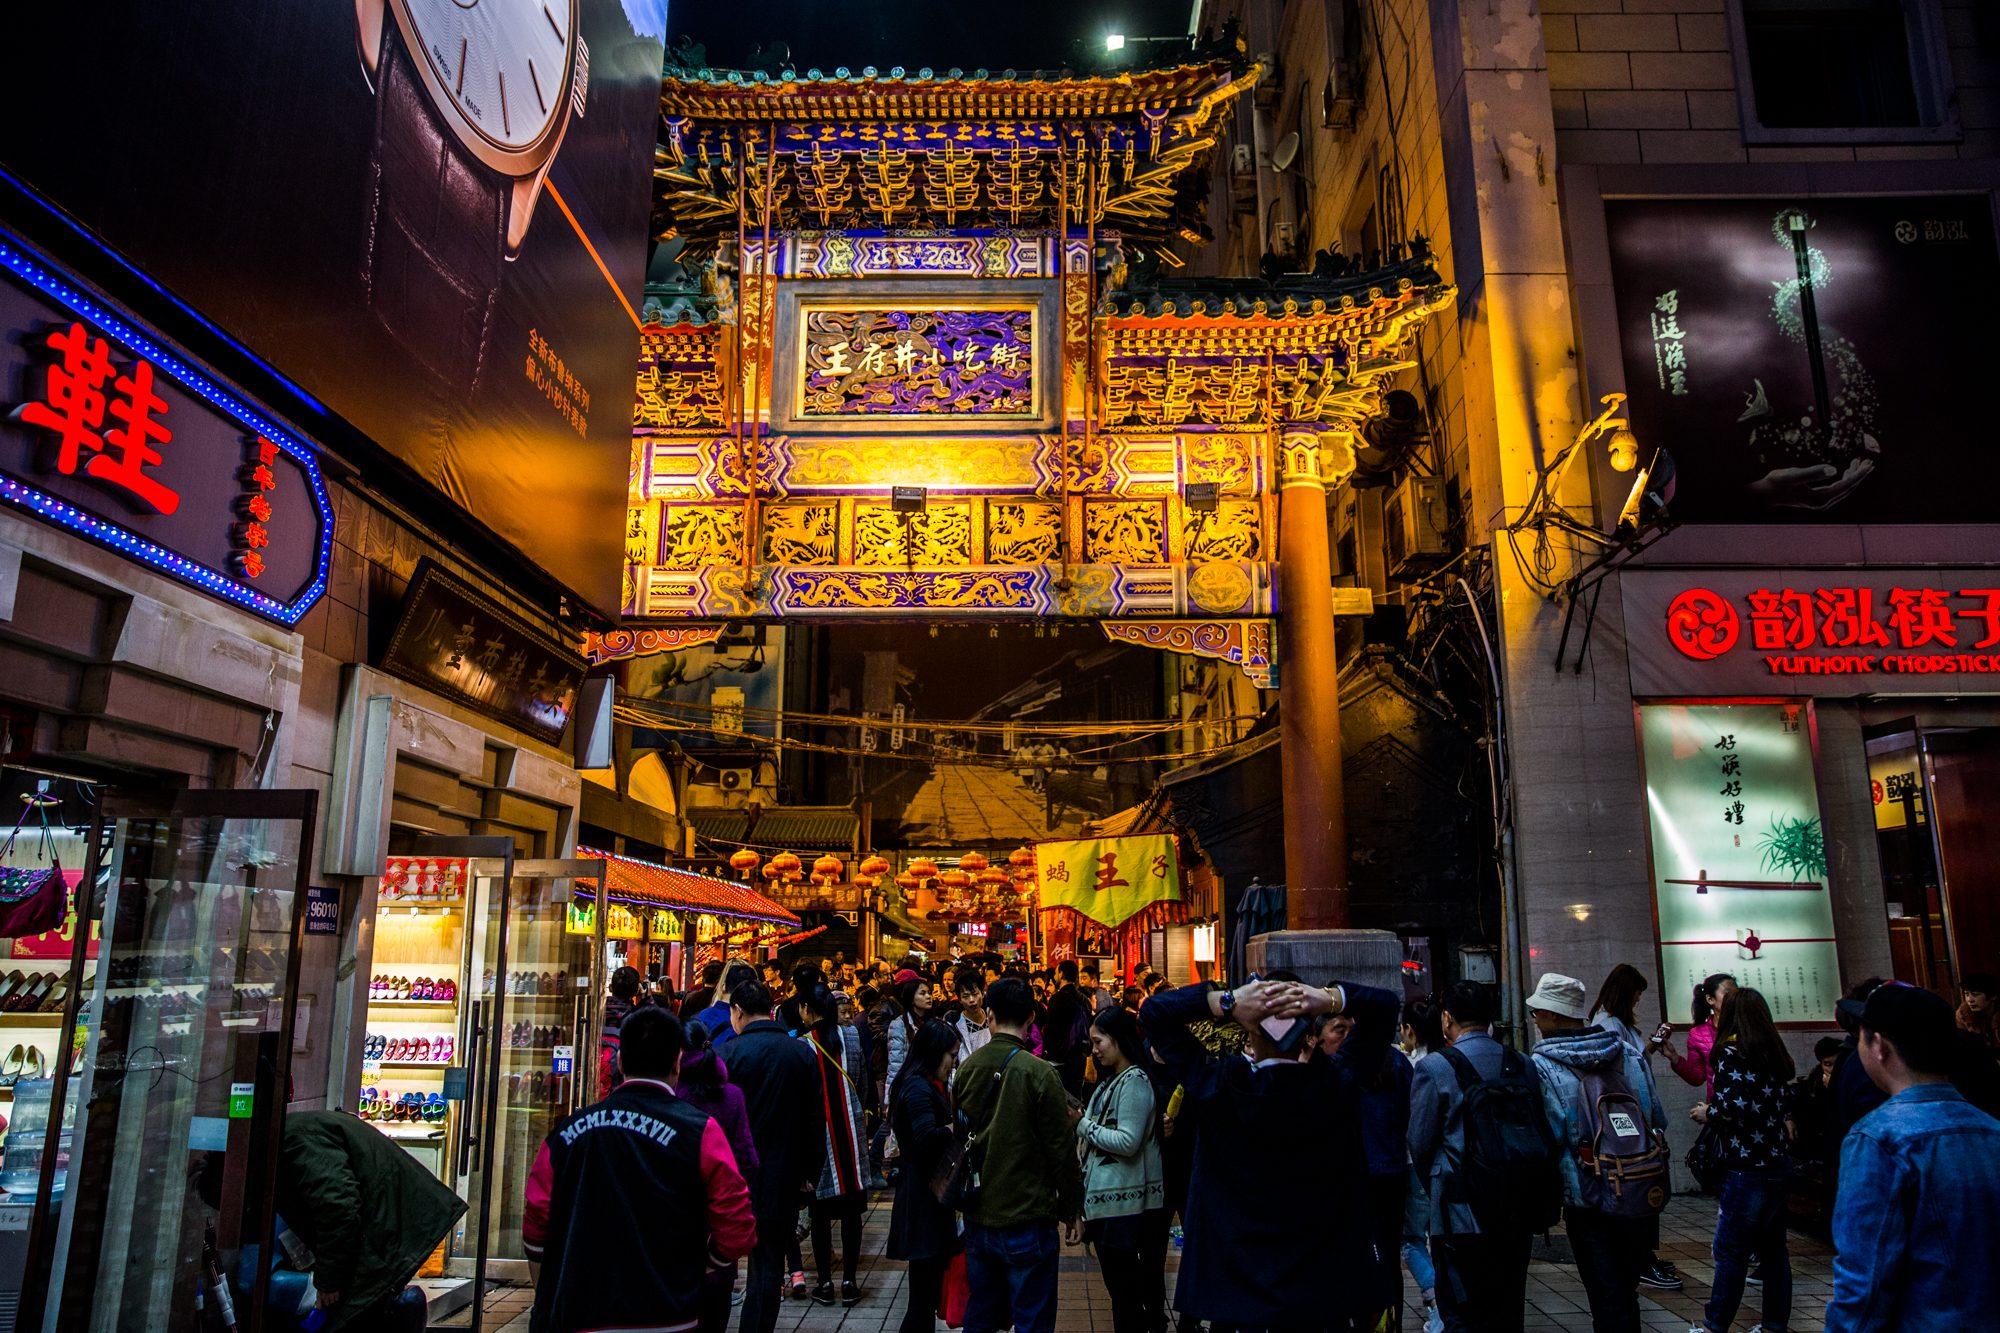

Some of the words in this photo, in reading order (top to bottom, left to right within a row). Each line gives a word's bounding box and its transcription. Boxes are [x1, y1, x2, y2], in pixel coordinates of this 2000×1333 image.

[464, 95, 483, 121] MADE
[528, 327, 590, 413] 全新布鲁纳系列
[820, 339, 1020, 377] 王府井小吃街
[20, 322, 180, 516] 鞋
[310, 901, 338, 918] 96010
[557, 1059, 569, 1072] 推
[560, 1108, 677, 1147] MCMLXXXVII
